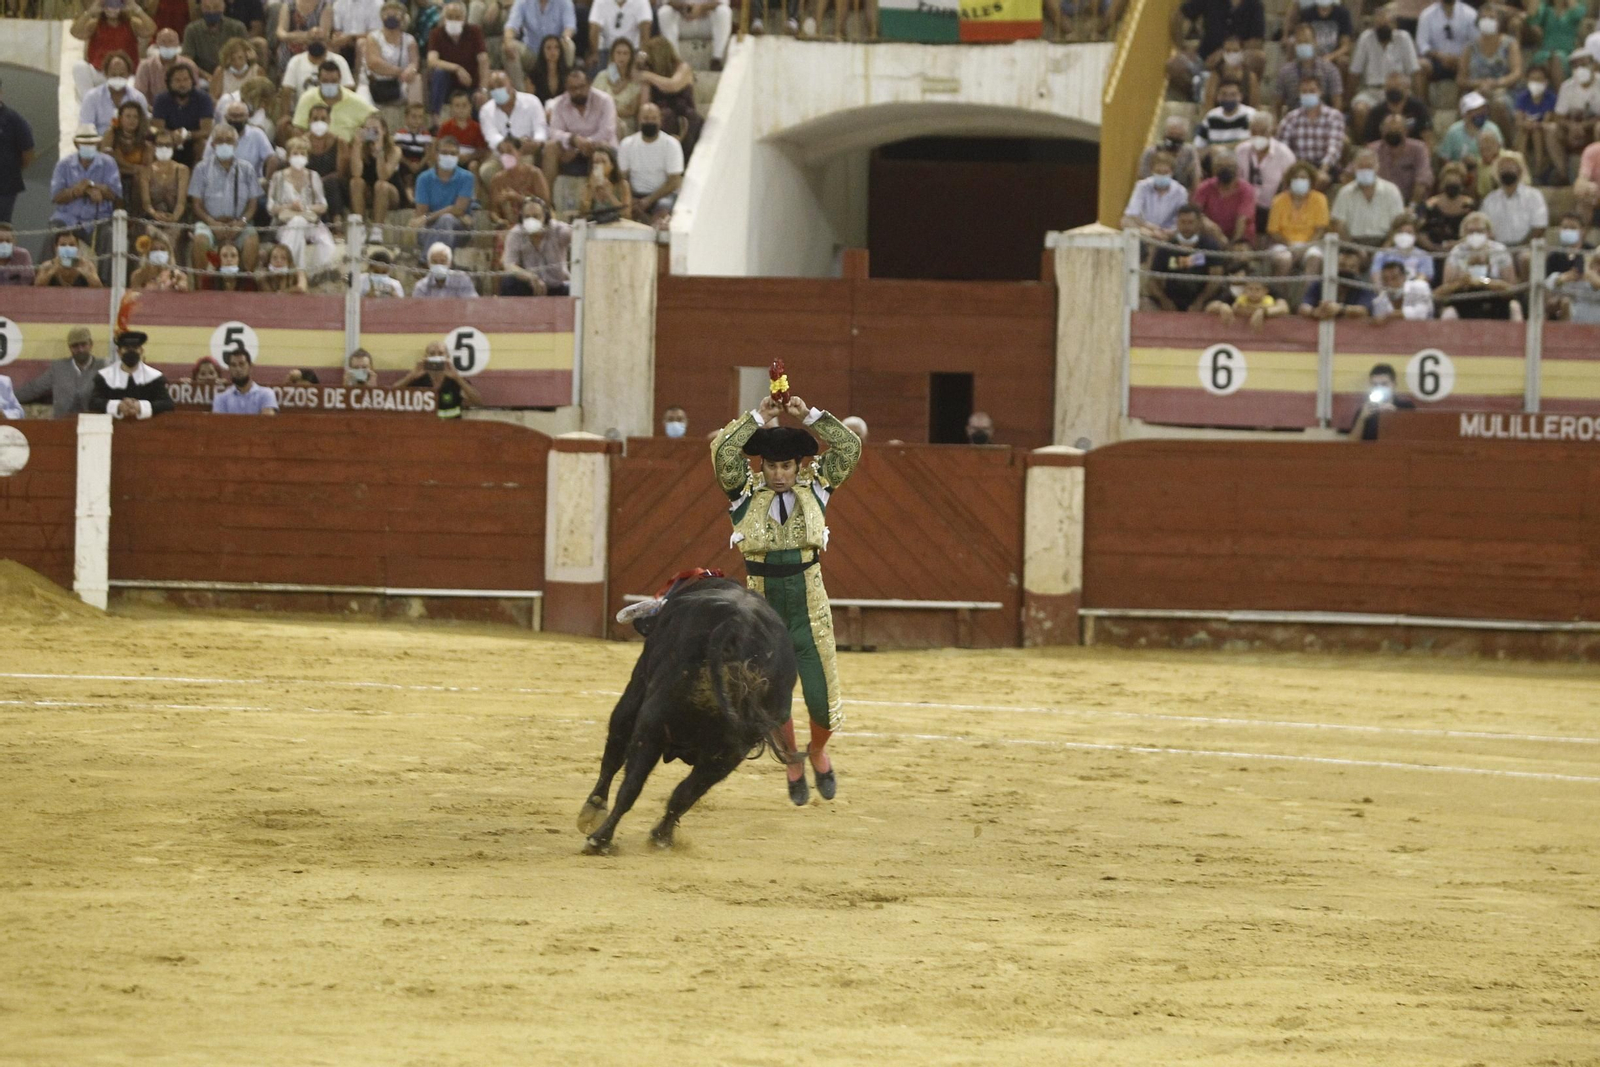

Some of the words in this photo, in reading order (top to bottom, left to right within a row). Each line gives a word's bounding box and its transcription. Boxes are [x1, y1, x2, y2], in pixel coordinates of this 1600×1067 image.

[223, 327, 245, 367] 5
[453, 332, 476, 371] 5
[1212, 349, 1233, 390] 6
[1419, 355, 1440, 396] 6
[273, 386, 319, 407] OZOS
[323, 387, 346, 409] DE
[350, 388, 436, 412] CABALLOS
